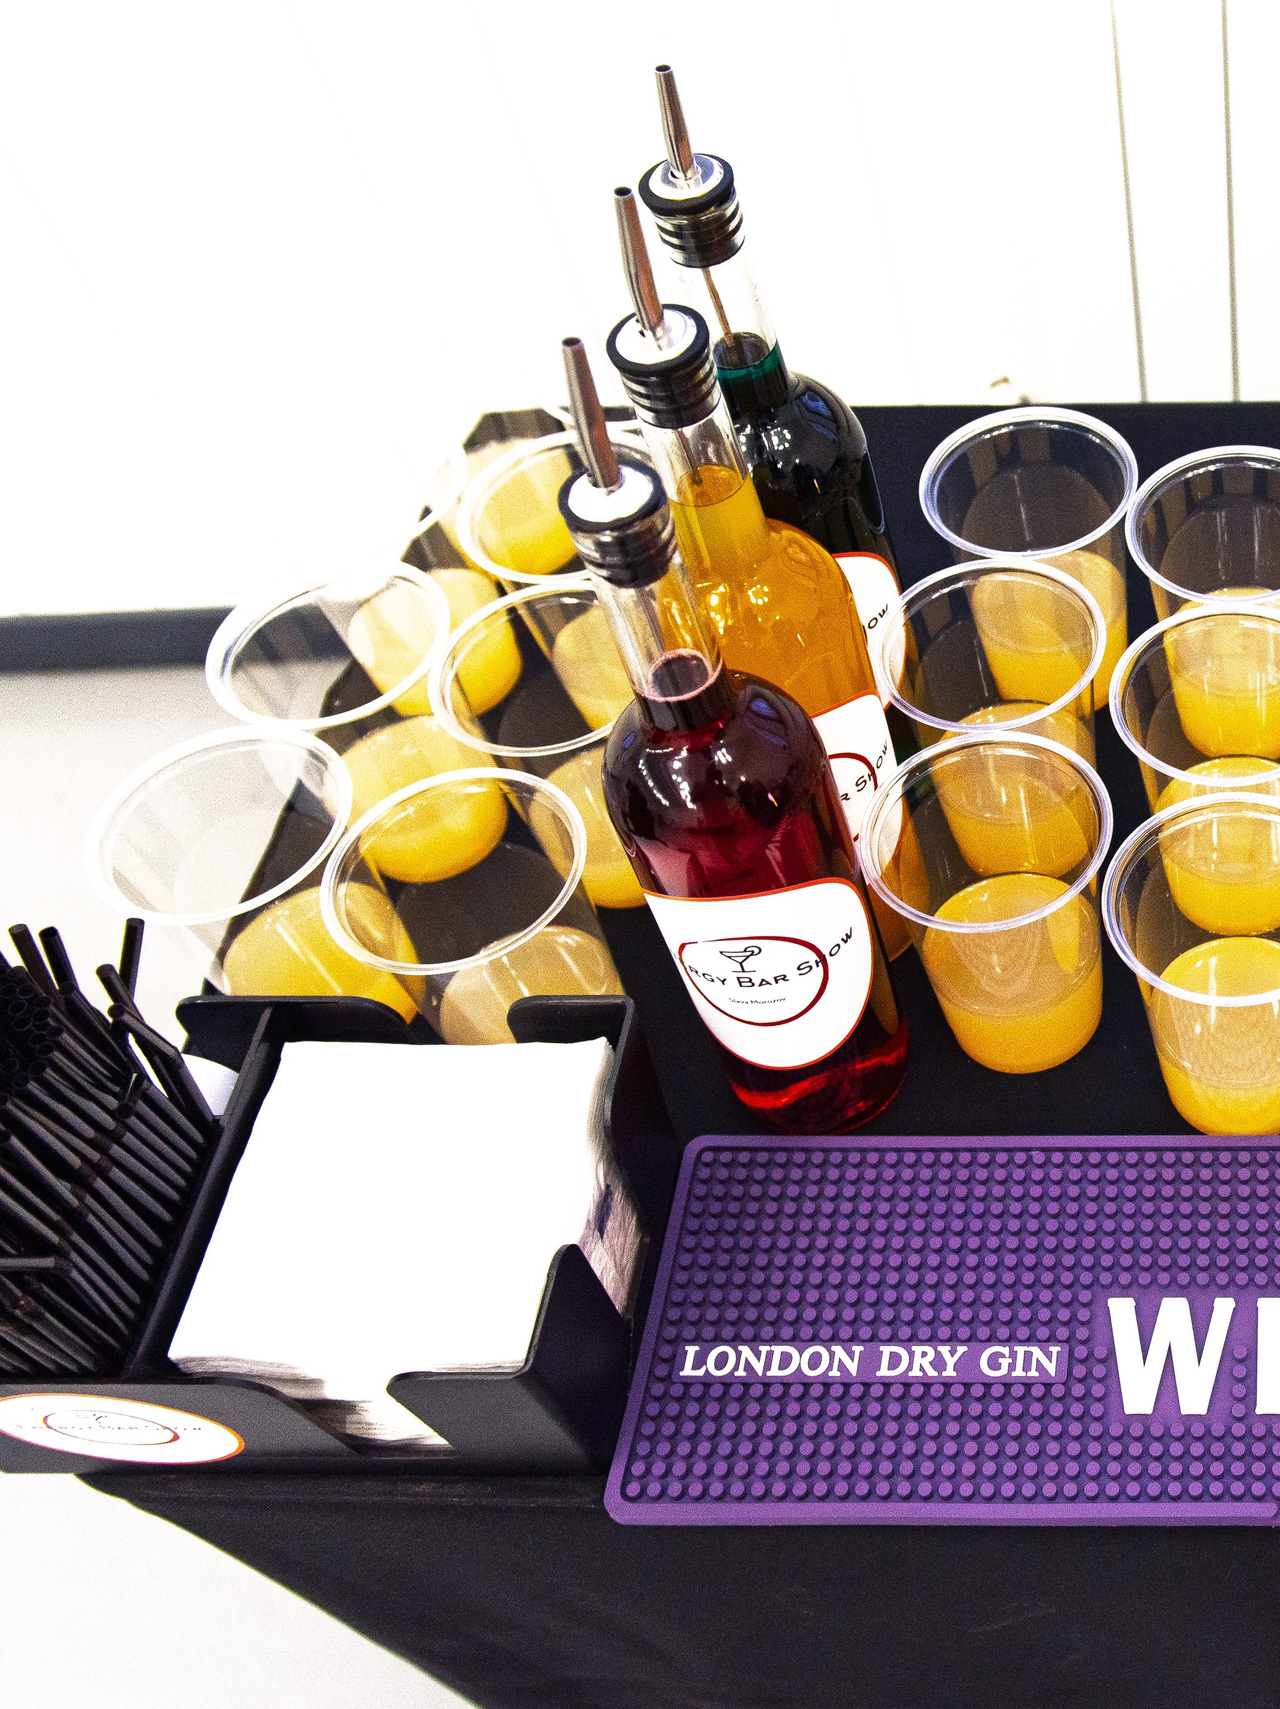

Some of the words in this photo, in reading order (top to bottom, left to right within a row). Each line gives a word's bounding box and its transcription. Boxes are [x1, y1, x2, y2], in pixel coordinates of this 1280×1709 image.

[866, 603, 889, 630] OW
[736, 974, 790, 988] BAR
[796, 926, 853, 976] SHOW
[680, 1346, 863, 1376] LONDON
[876, 1346, 967, 1376] DRY
[980, 1346, 1060, 1376] GIN
